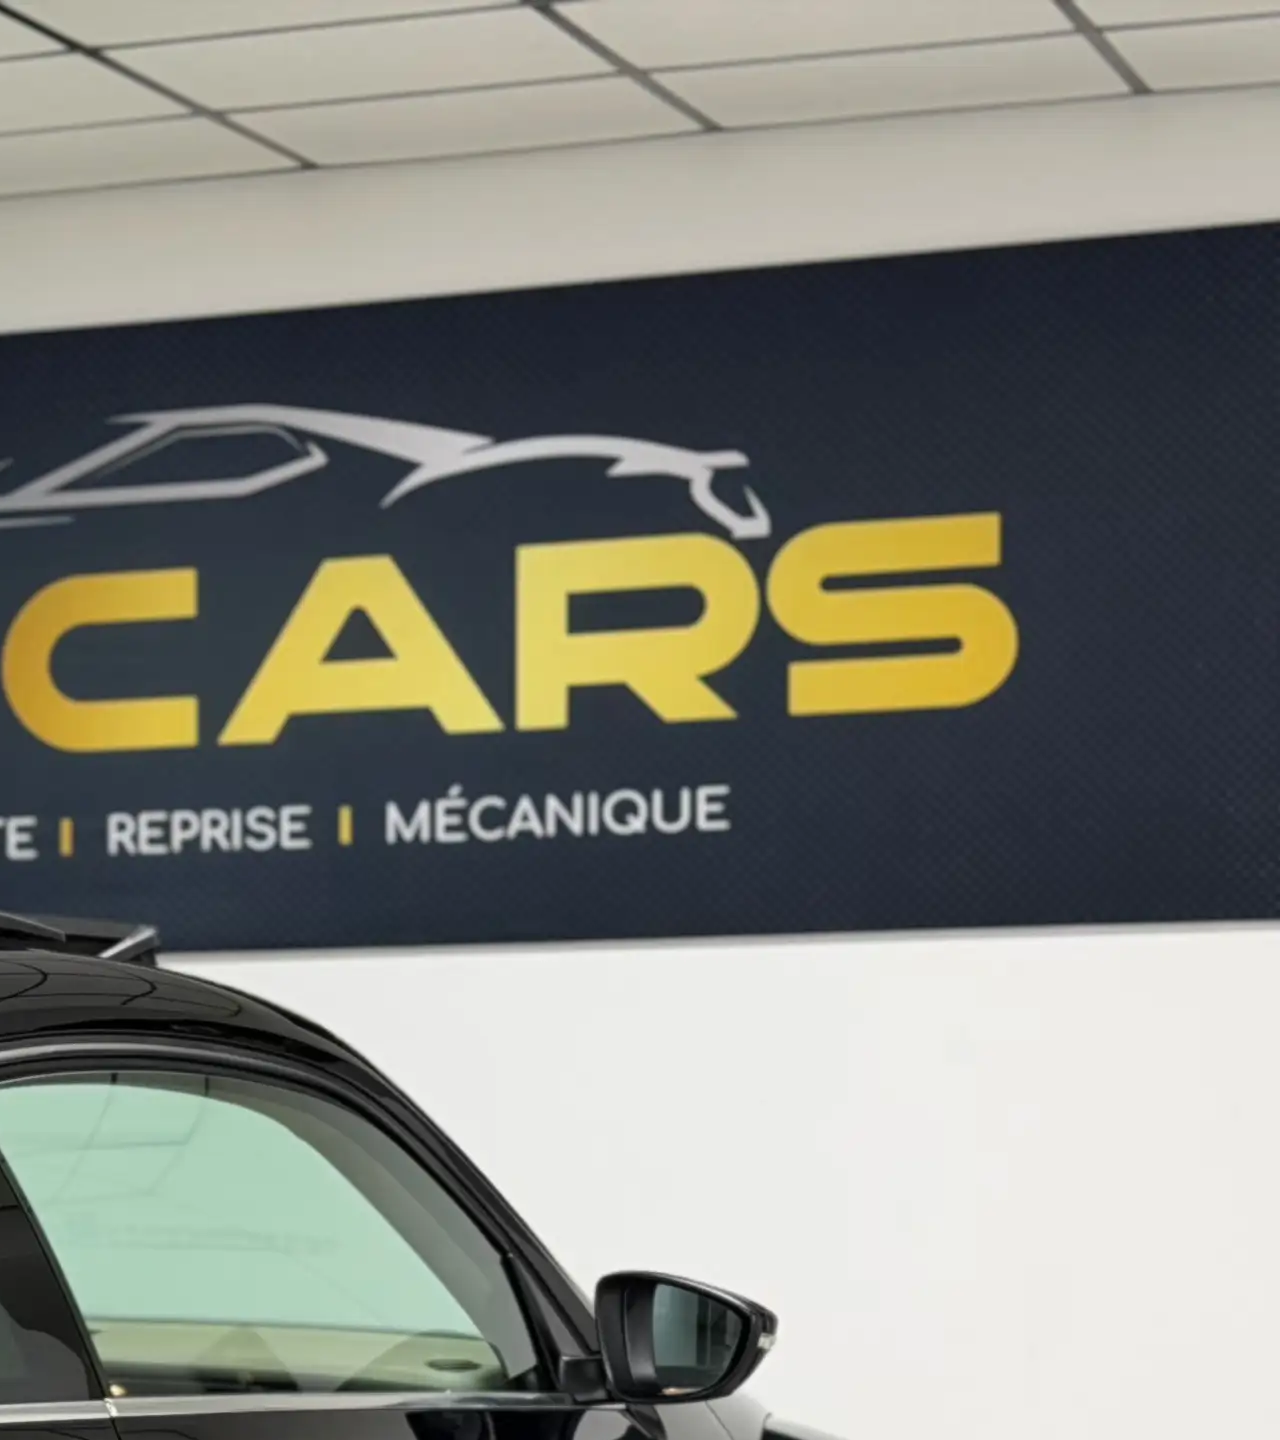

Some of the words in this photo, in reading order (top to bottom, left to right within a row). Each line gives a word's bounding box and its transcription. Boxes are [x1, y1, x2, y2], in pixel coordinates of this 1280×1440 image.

[0, 511, 1020, 754] CARS
[106, 804, 313, 856] REPRISE
[384, 784, 731, 845] MÉCANIQUE
